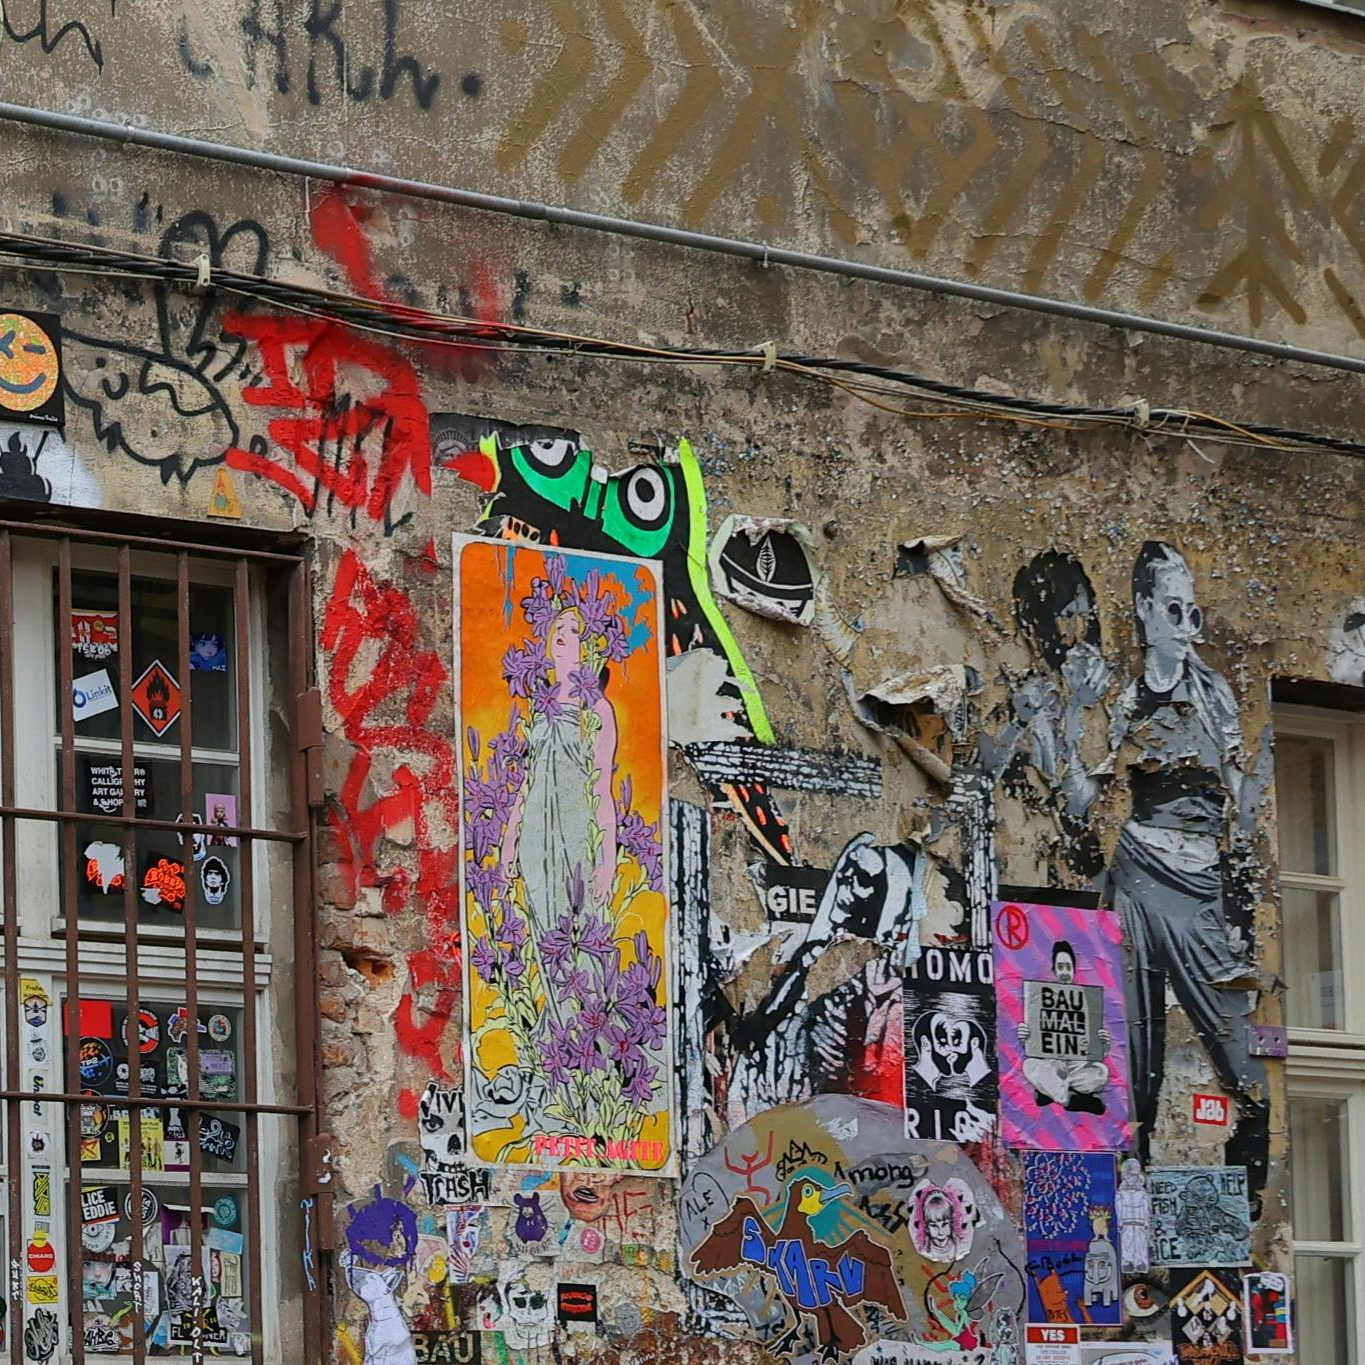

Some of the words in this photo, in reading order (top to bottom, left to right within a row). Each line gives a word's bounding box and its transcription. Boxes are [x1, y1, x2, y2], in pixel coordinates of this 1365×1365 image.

[85, 684, 112, 701] Linkit
[92, 788, 108, 797] ART
[1041, 986, 1084, 1011] BAU
[1040, 1010, 1086, 1034] MAL
[83, 1201, 118, 1221] EDDIE
[28, 1253, 54, 1261] CHIARO
[1039, 1328, 1066, 1342] YES
